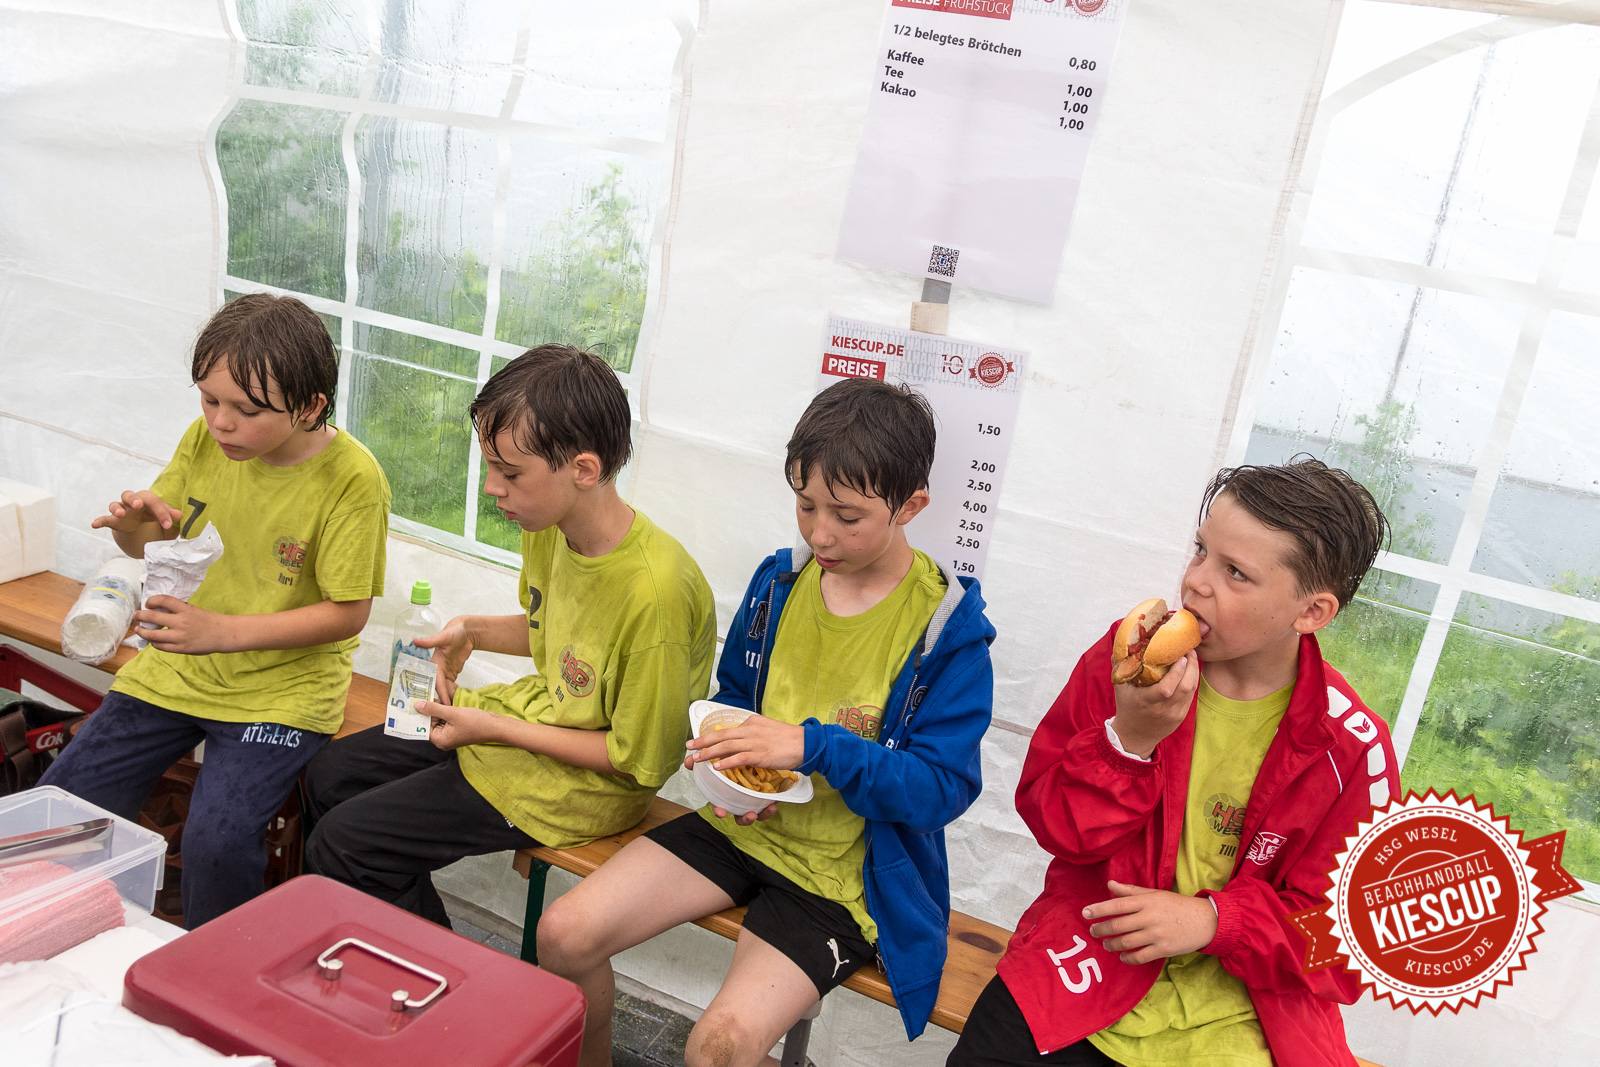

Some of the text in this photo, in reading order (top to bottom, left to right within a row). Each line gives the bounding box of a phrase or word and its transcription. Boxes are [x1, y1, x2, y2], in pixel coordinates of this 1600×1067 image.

[893, 24, 1022, 58] 1/2 belegtes Brötchen
[887, 49, 925, 66] Kaffee
[1068, 57, 1097, 72] 0,80
[884, 65, 904, 79] Tee
[880, 81, 916, 98] Kakao
[1066, 84, 1092, 98] 1,00
[1062, 100, 1088, 115] 1,00
[1058, 116, 1084, 131] 1,00
[832, 335, 904, 357] KIESCUP.DE
[828, 357, 879, 379] PREISE
[977, 423, 1001, 436] 1,50
[970, 460, 996, 473] 2,00
[967, 479, 992, 492] 2,50
[962, 500, 988, 514] 4,00
[181, 497, 207, 538] 7
[959, 519, 984, 533] 2,50
[955, 536, 980, 550] 2,50
[952, 560, 975, 574] 1,50
[529, 585, 542, 629] 2
[391, 697, 405, 709] 5
[836, 707, 880, 733] HSG
[35, 731, 64, 749] Cok
[1212, 801, 1247, 829] HS
[1213, 820, 1243, 836] WES
[1046, 934, 1103, 994] 15
